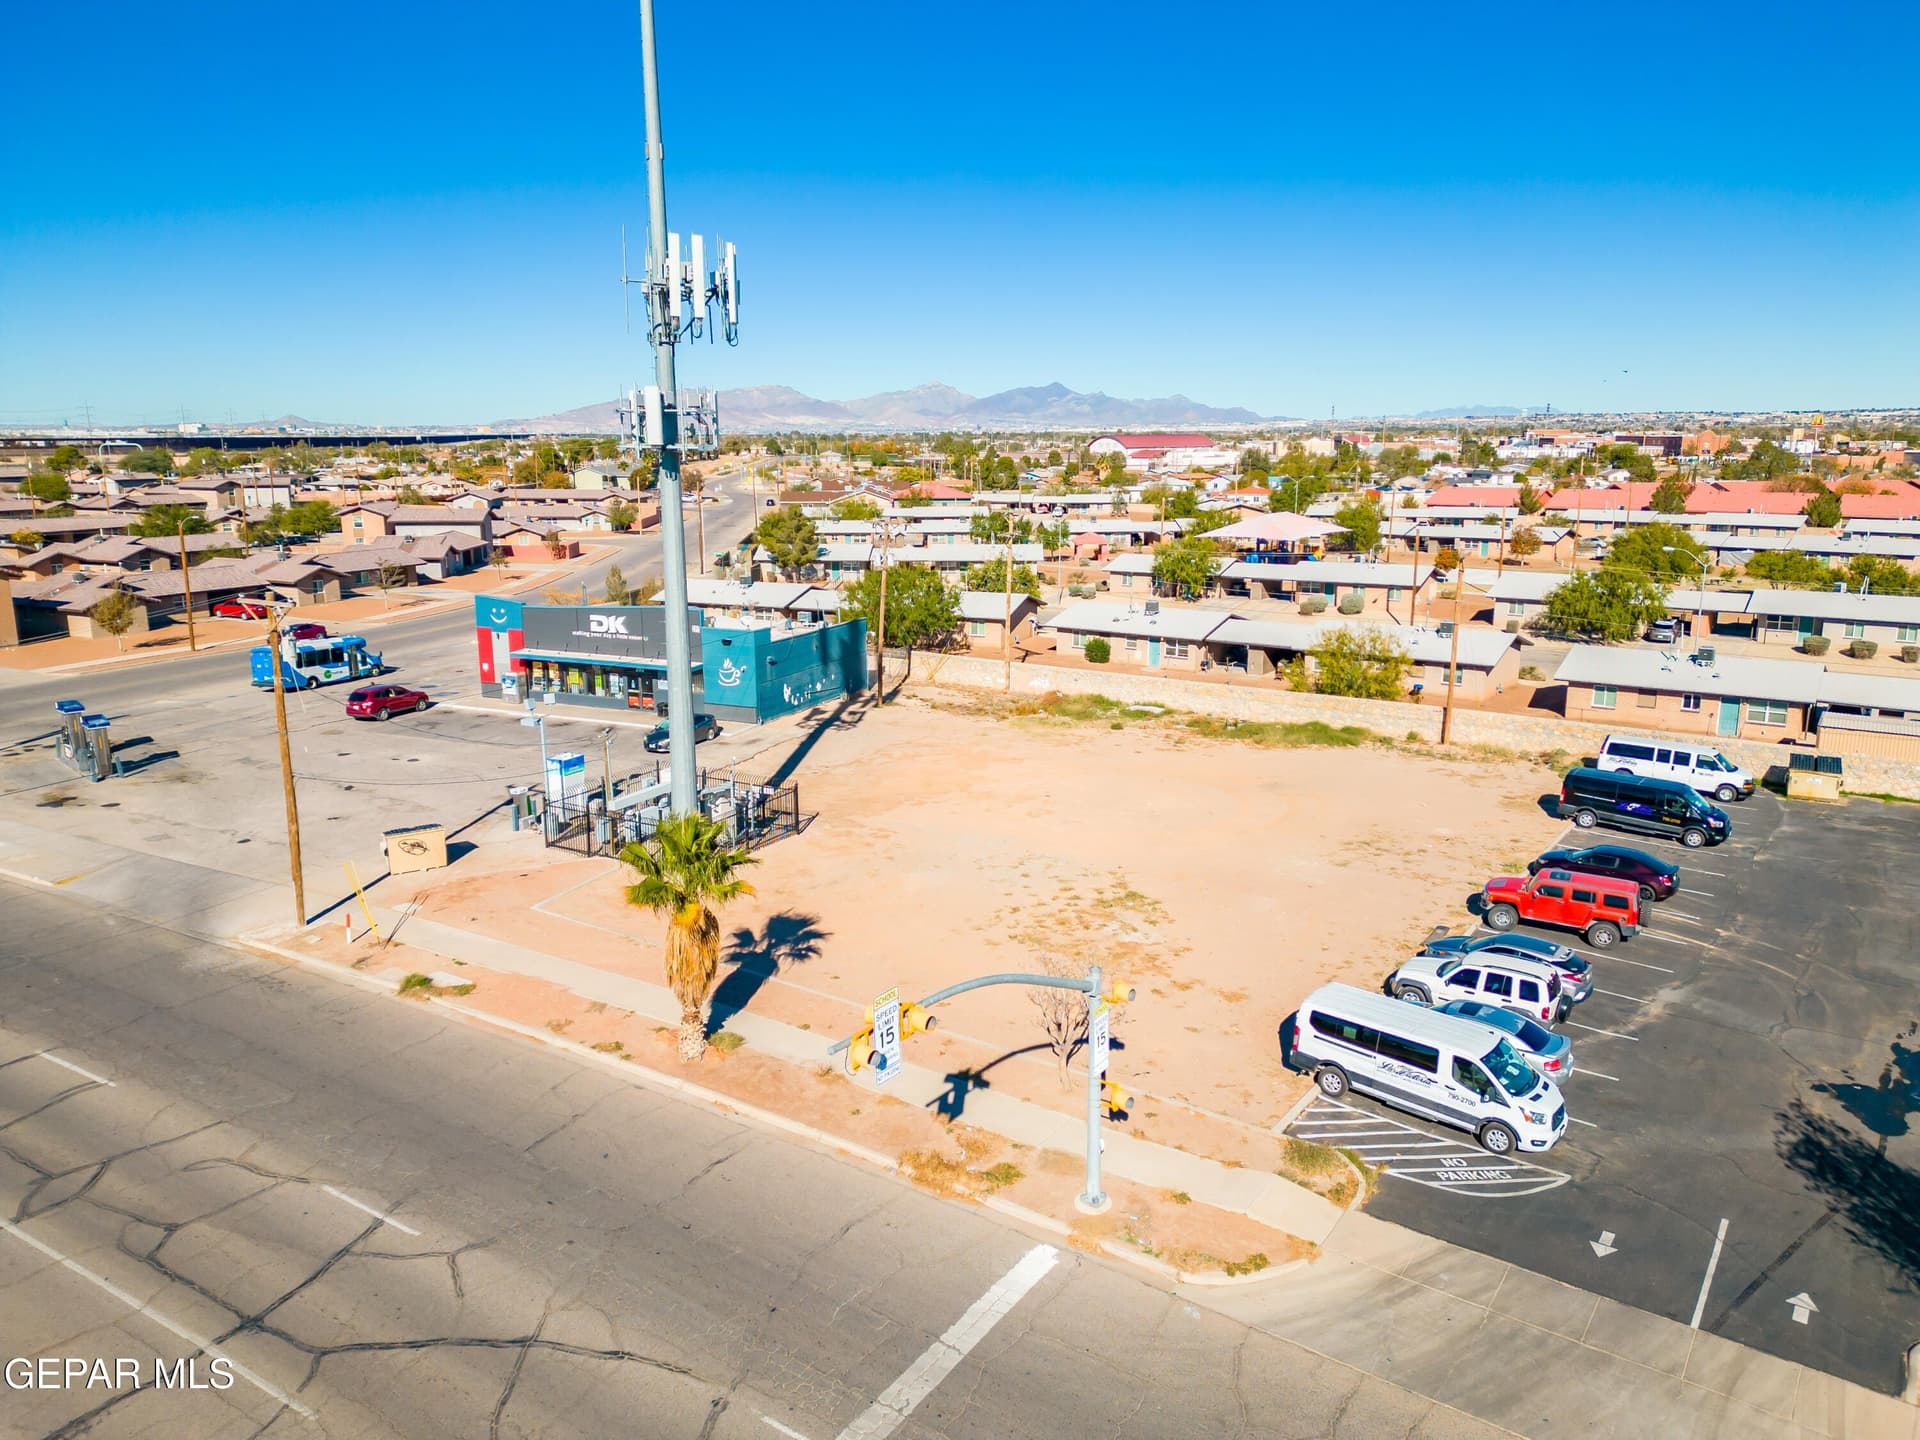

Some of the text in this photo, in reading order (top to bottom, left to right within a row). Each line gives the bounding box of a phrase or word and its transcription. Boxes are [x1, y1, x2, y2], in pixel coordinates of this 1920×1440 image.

[589, 614, 628, 634] DK
[876, 1004, 897, 1022] SPEED
[878, 1015, 894, 1031] LIMIT
[880, 1025, 895, 1048] 15
[1097, 1031, 1106, 1048] 15
[1440, 1158, 1468, 1167] NO
[1436, 1170, 1512, 1180] PARKING
